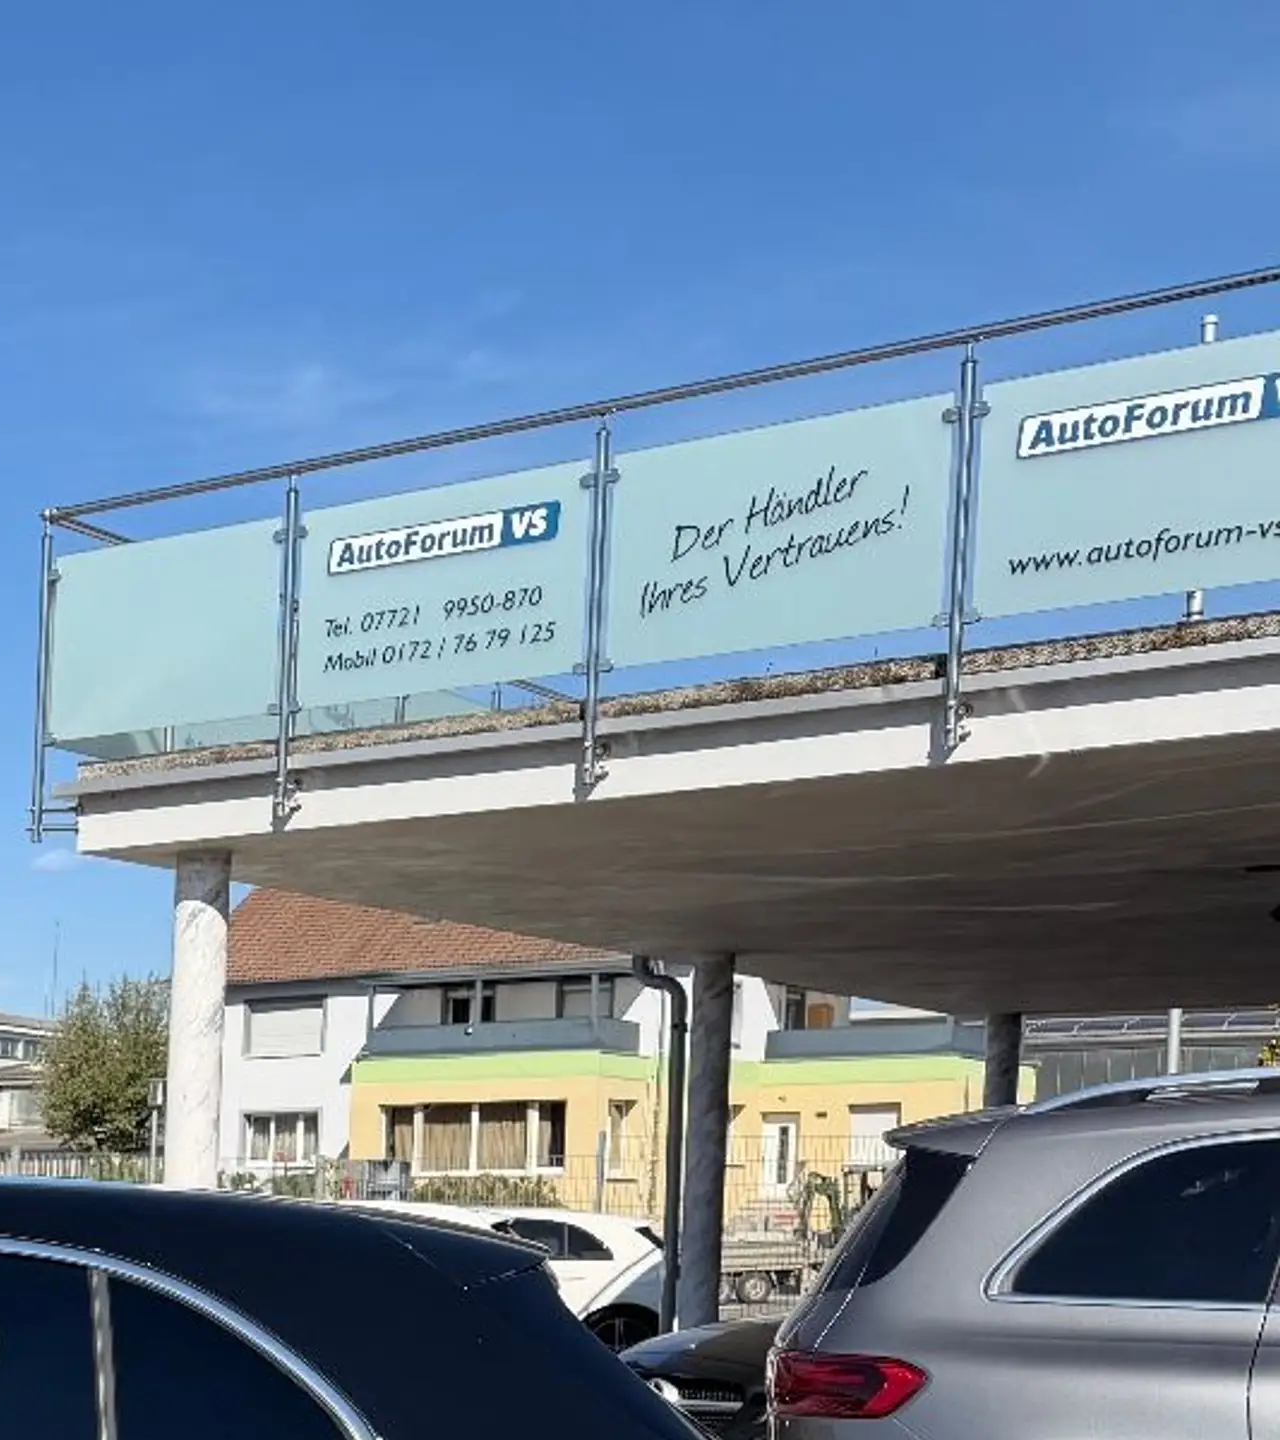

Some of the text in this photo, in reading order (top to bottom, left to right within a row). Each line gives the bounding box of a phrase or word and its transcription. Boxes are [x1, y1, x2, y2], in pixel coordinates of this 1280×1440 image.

[1027, 390, 1253, 451] AutoForum
[337, 508, 547, 567] AutoForum VS
[671, 465, 868, 562] Der Händler
[639, 484, 910, 618] Ihres Vertrauens!
[325, 585, 542, 638] Tel. 07721 9950-870
[322, 649, 377, 673] Mobil
[382, 641, 432, 664] 0172
[453, 634, 477, 654] 76
[484, 627, 511, 648] 79
[519, 622, 556, 644] 125
